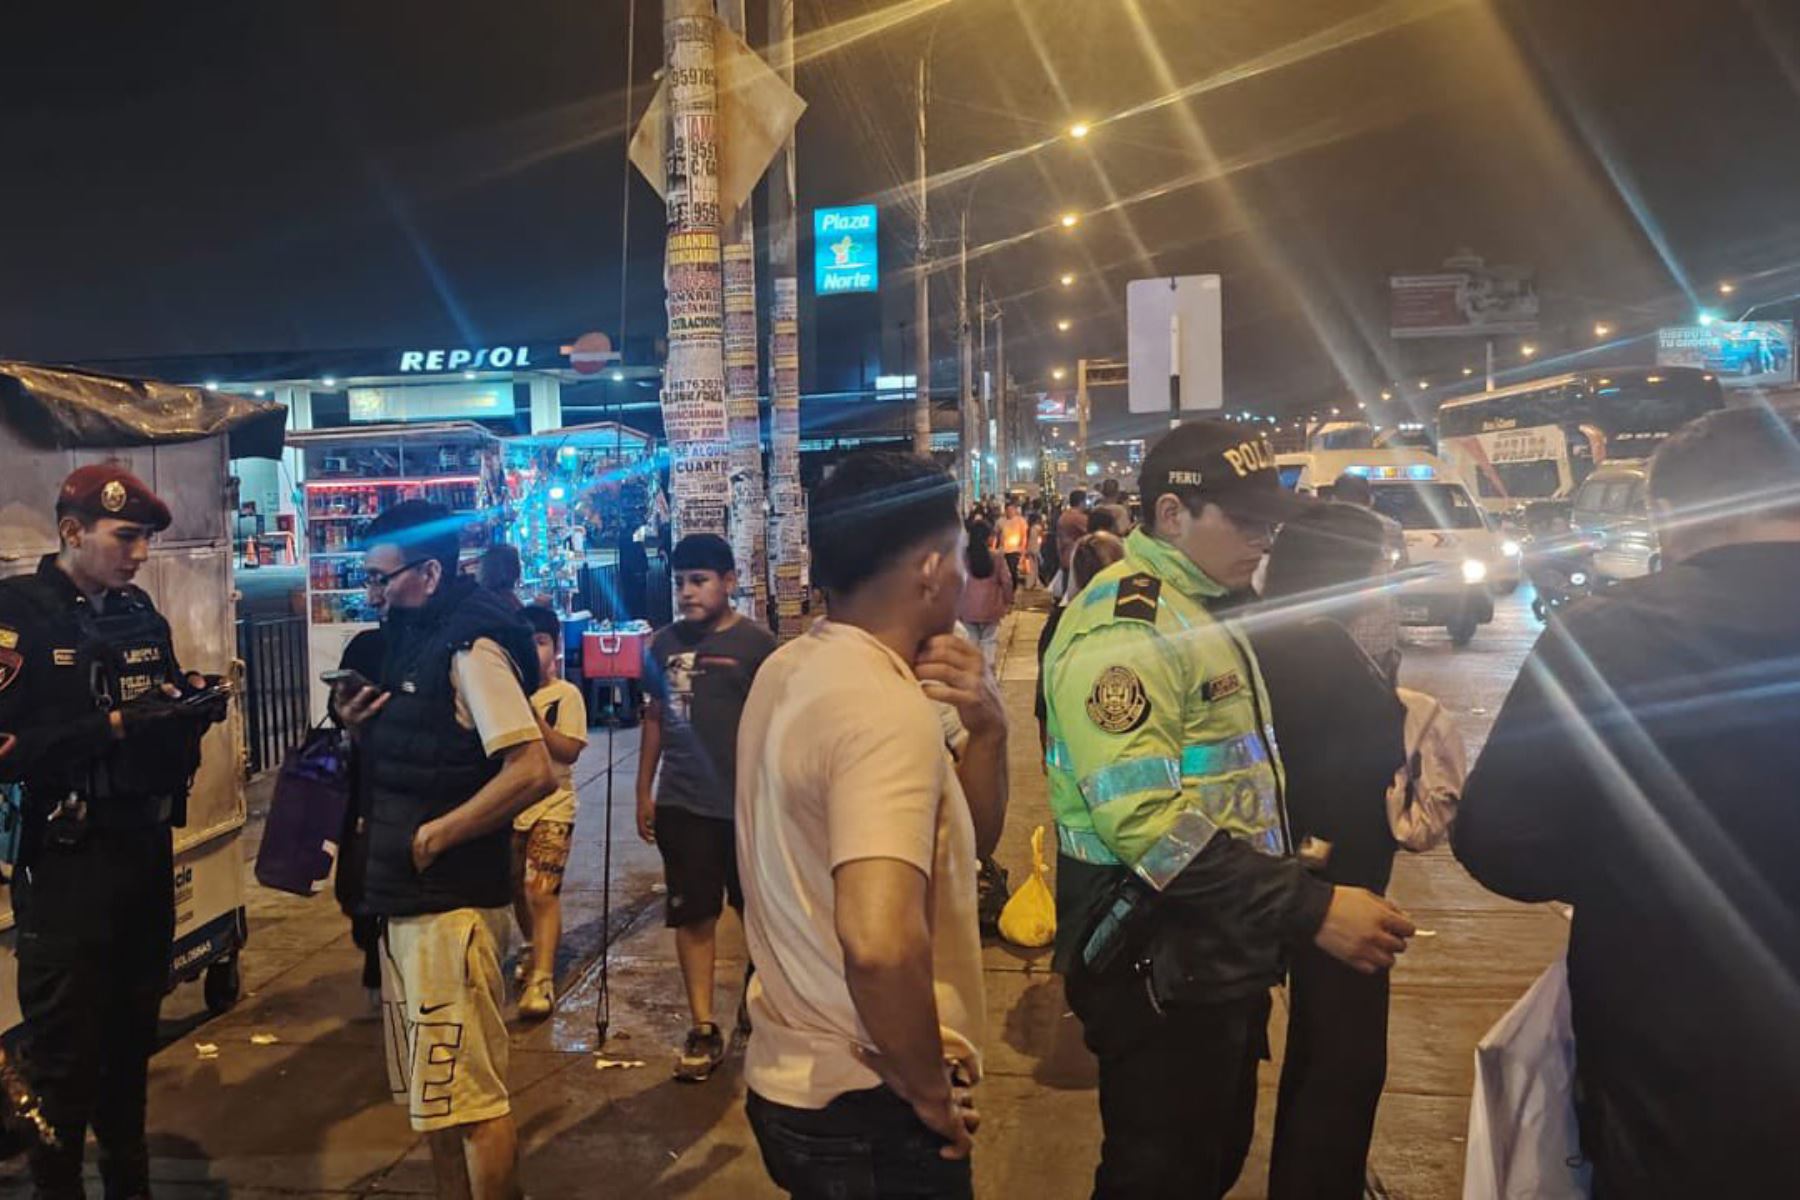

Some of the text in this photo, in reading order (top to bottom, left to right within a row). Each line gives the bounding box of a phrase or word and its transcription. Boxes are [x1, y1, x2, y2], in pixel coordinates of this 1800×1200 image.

[822, 213, 870, 231] Plaza
[823, 272, 871, 291] Norte
[400, 346, 531, 371] REPSOL
[1168, 470, 1202, 486] PERU
